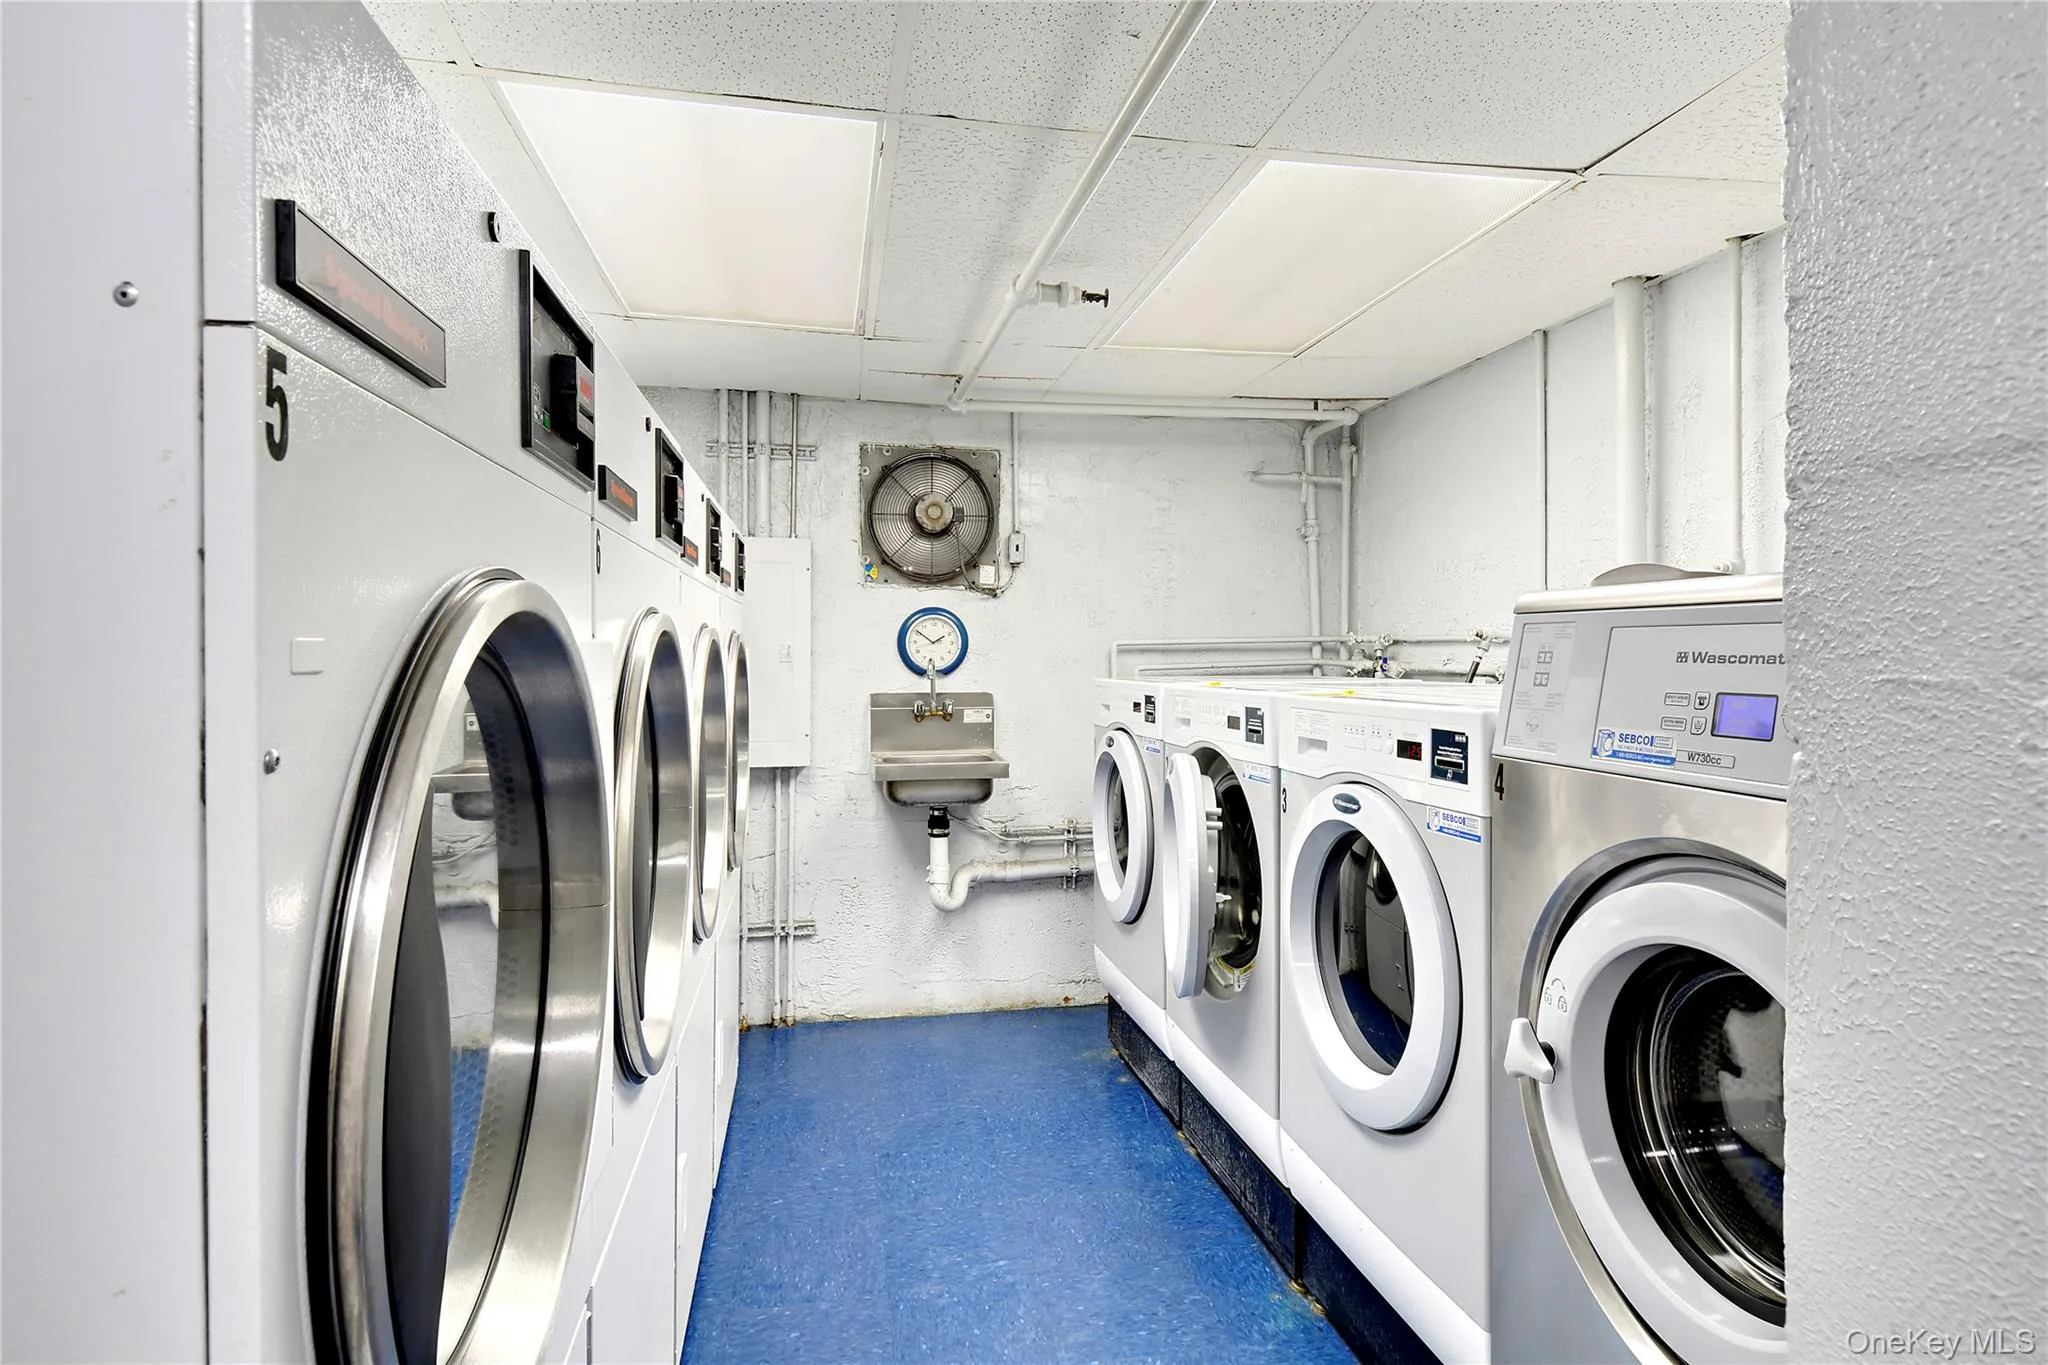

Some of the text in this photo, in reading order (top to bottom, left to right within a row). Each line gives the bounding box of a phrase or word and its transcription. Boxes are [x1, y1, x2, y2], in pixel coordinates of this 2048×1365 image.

[265, 345, 289, 462] 5
[595, 527, 601, 575] 6
[1691, 651, 1786, 665] Wascomat
[1618, 732, 1650, 746] SEBCO
[1687, 752, 1722, 765] W730cc
[1494, 763, 1505, 801] 4
[1281, 787, 1288, 814] 3
[1442, 812, 1462, 825] SEBCO
